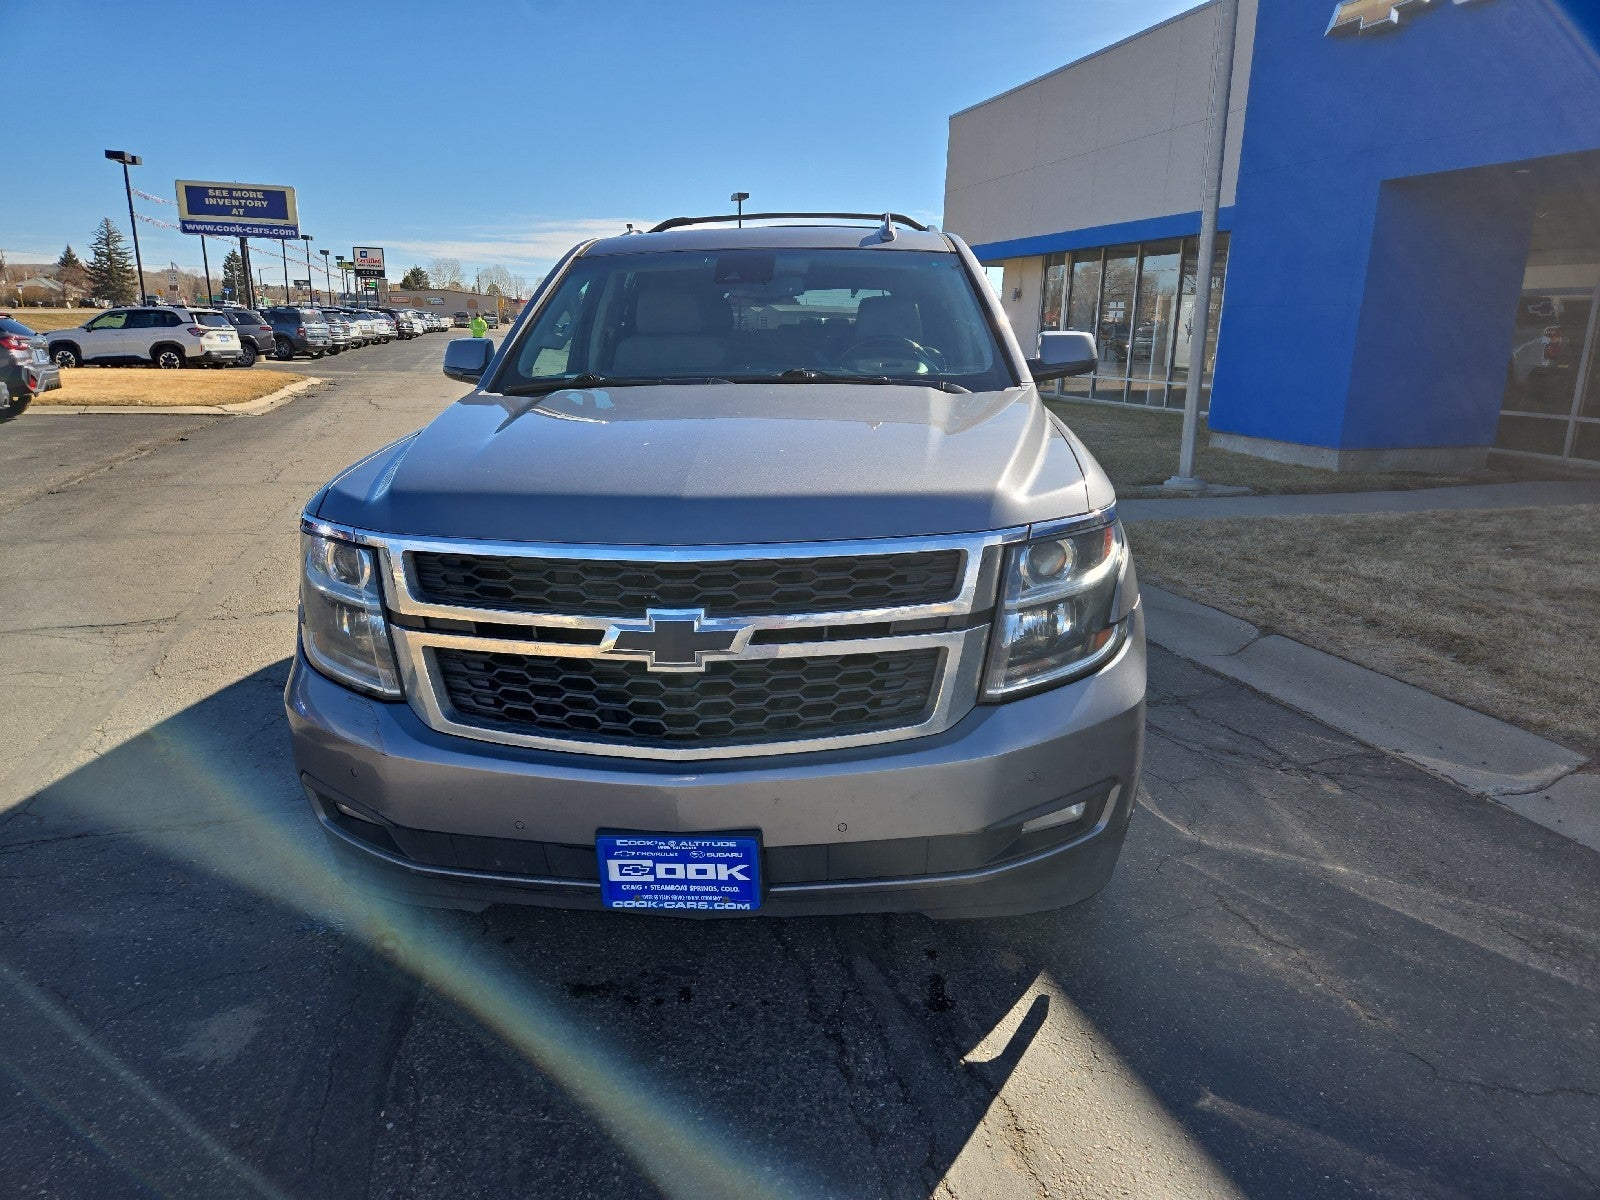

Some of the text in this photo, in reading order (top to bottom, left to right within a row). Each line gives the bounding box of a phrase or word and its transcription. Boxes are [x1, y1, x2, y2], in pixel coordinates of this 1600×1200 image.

[208, 189, 264, 199] SEE MORE
[205, 198, 268, 208] INVENTORY
[184, 223, 296, 236] www.cook-cars.com
[606, 859, 751, 882] COOK
[612, 900, 751, 910] COOK-CARS.COM
